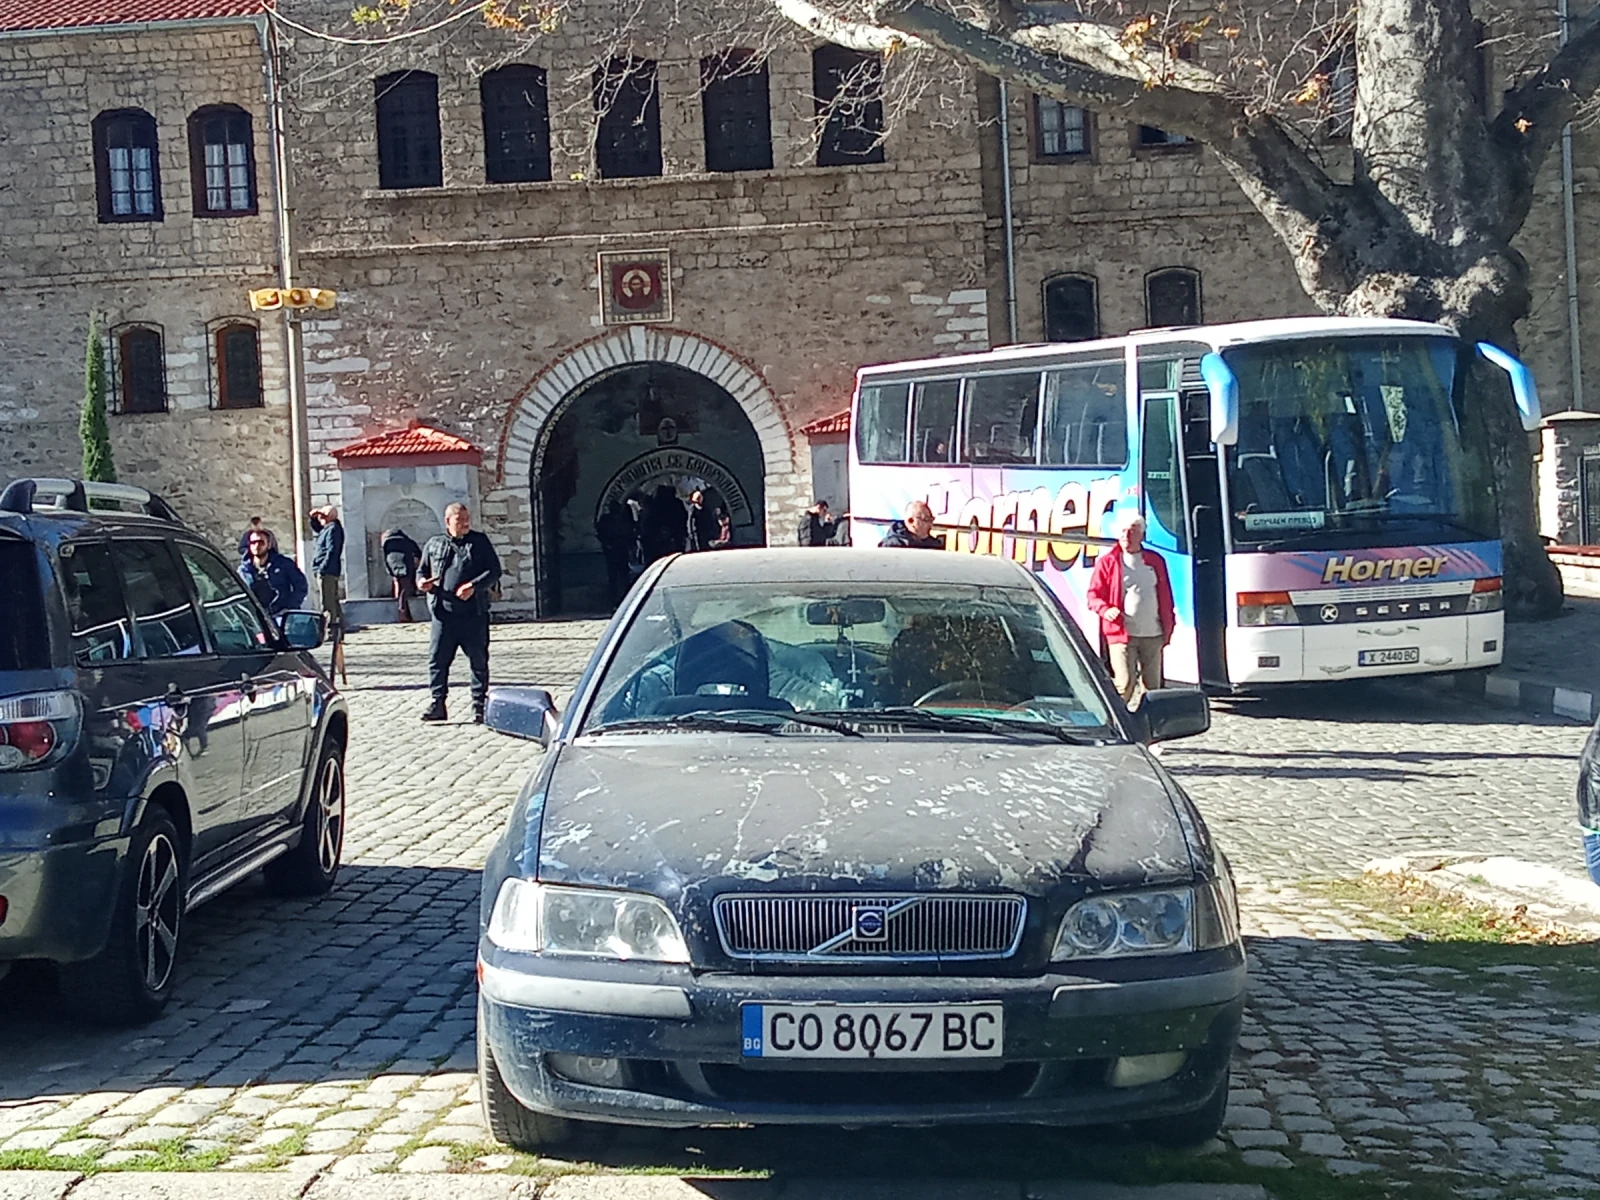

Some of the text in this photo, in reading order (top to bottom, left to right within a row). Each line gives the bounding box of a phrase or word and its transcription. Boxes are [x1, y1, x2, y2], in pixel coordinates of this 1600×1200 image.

[923, 473, 1121, 572] Horner
[1320, 554, 1449, 583] Horner
[1355, 601, 1451, 616] SETRA
[1379, 651, 1402, 662] 2440
[1404, 650, 1416, 661] BC
[743, 1012, 996, 1052] BG CO 8067 BC
